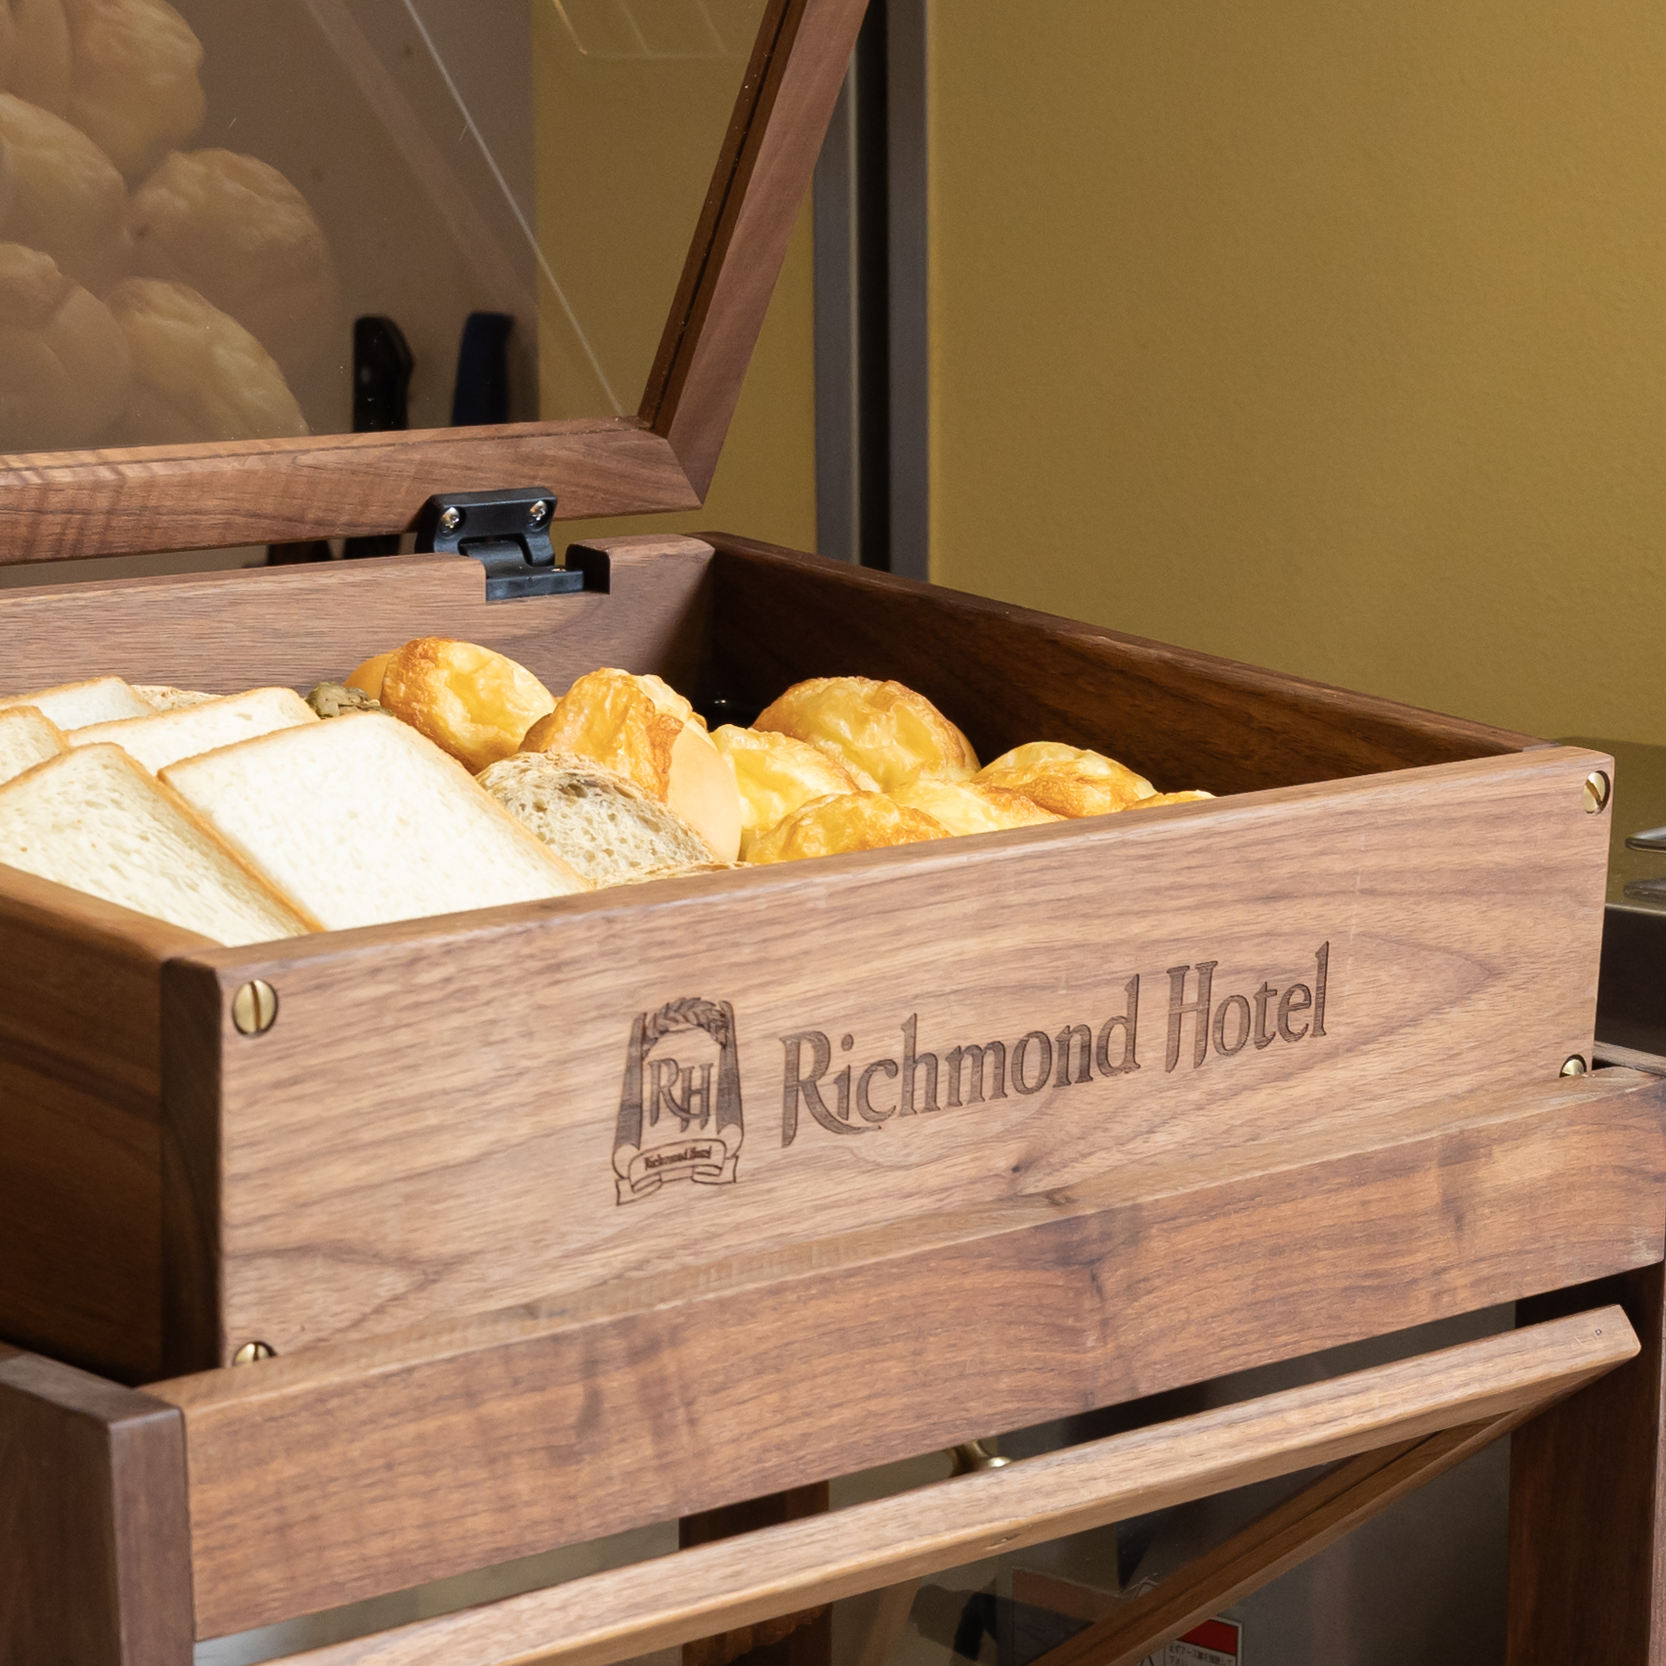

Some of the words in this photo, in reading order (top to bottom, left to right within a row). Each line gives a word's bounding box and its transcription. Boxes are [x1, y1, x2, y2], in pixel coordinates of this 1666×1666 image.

[649, 1051, 712, 1132] RH
[779, 974, 1140, 1148] Richmond
[1164, 941, 1331, 1074] Hotel
